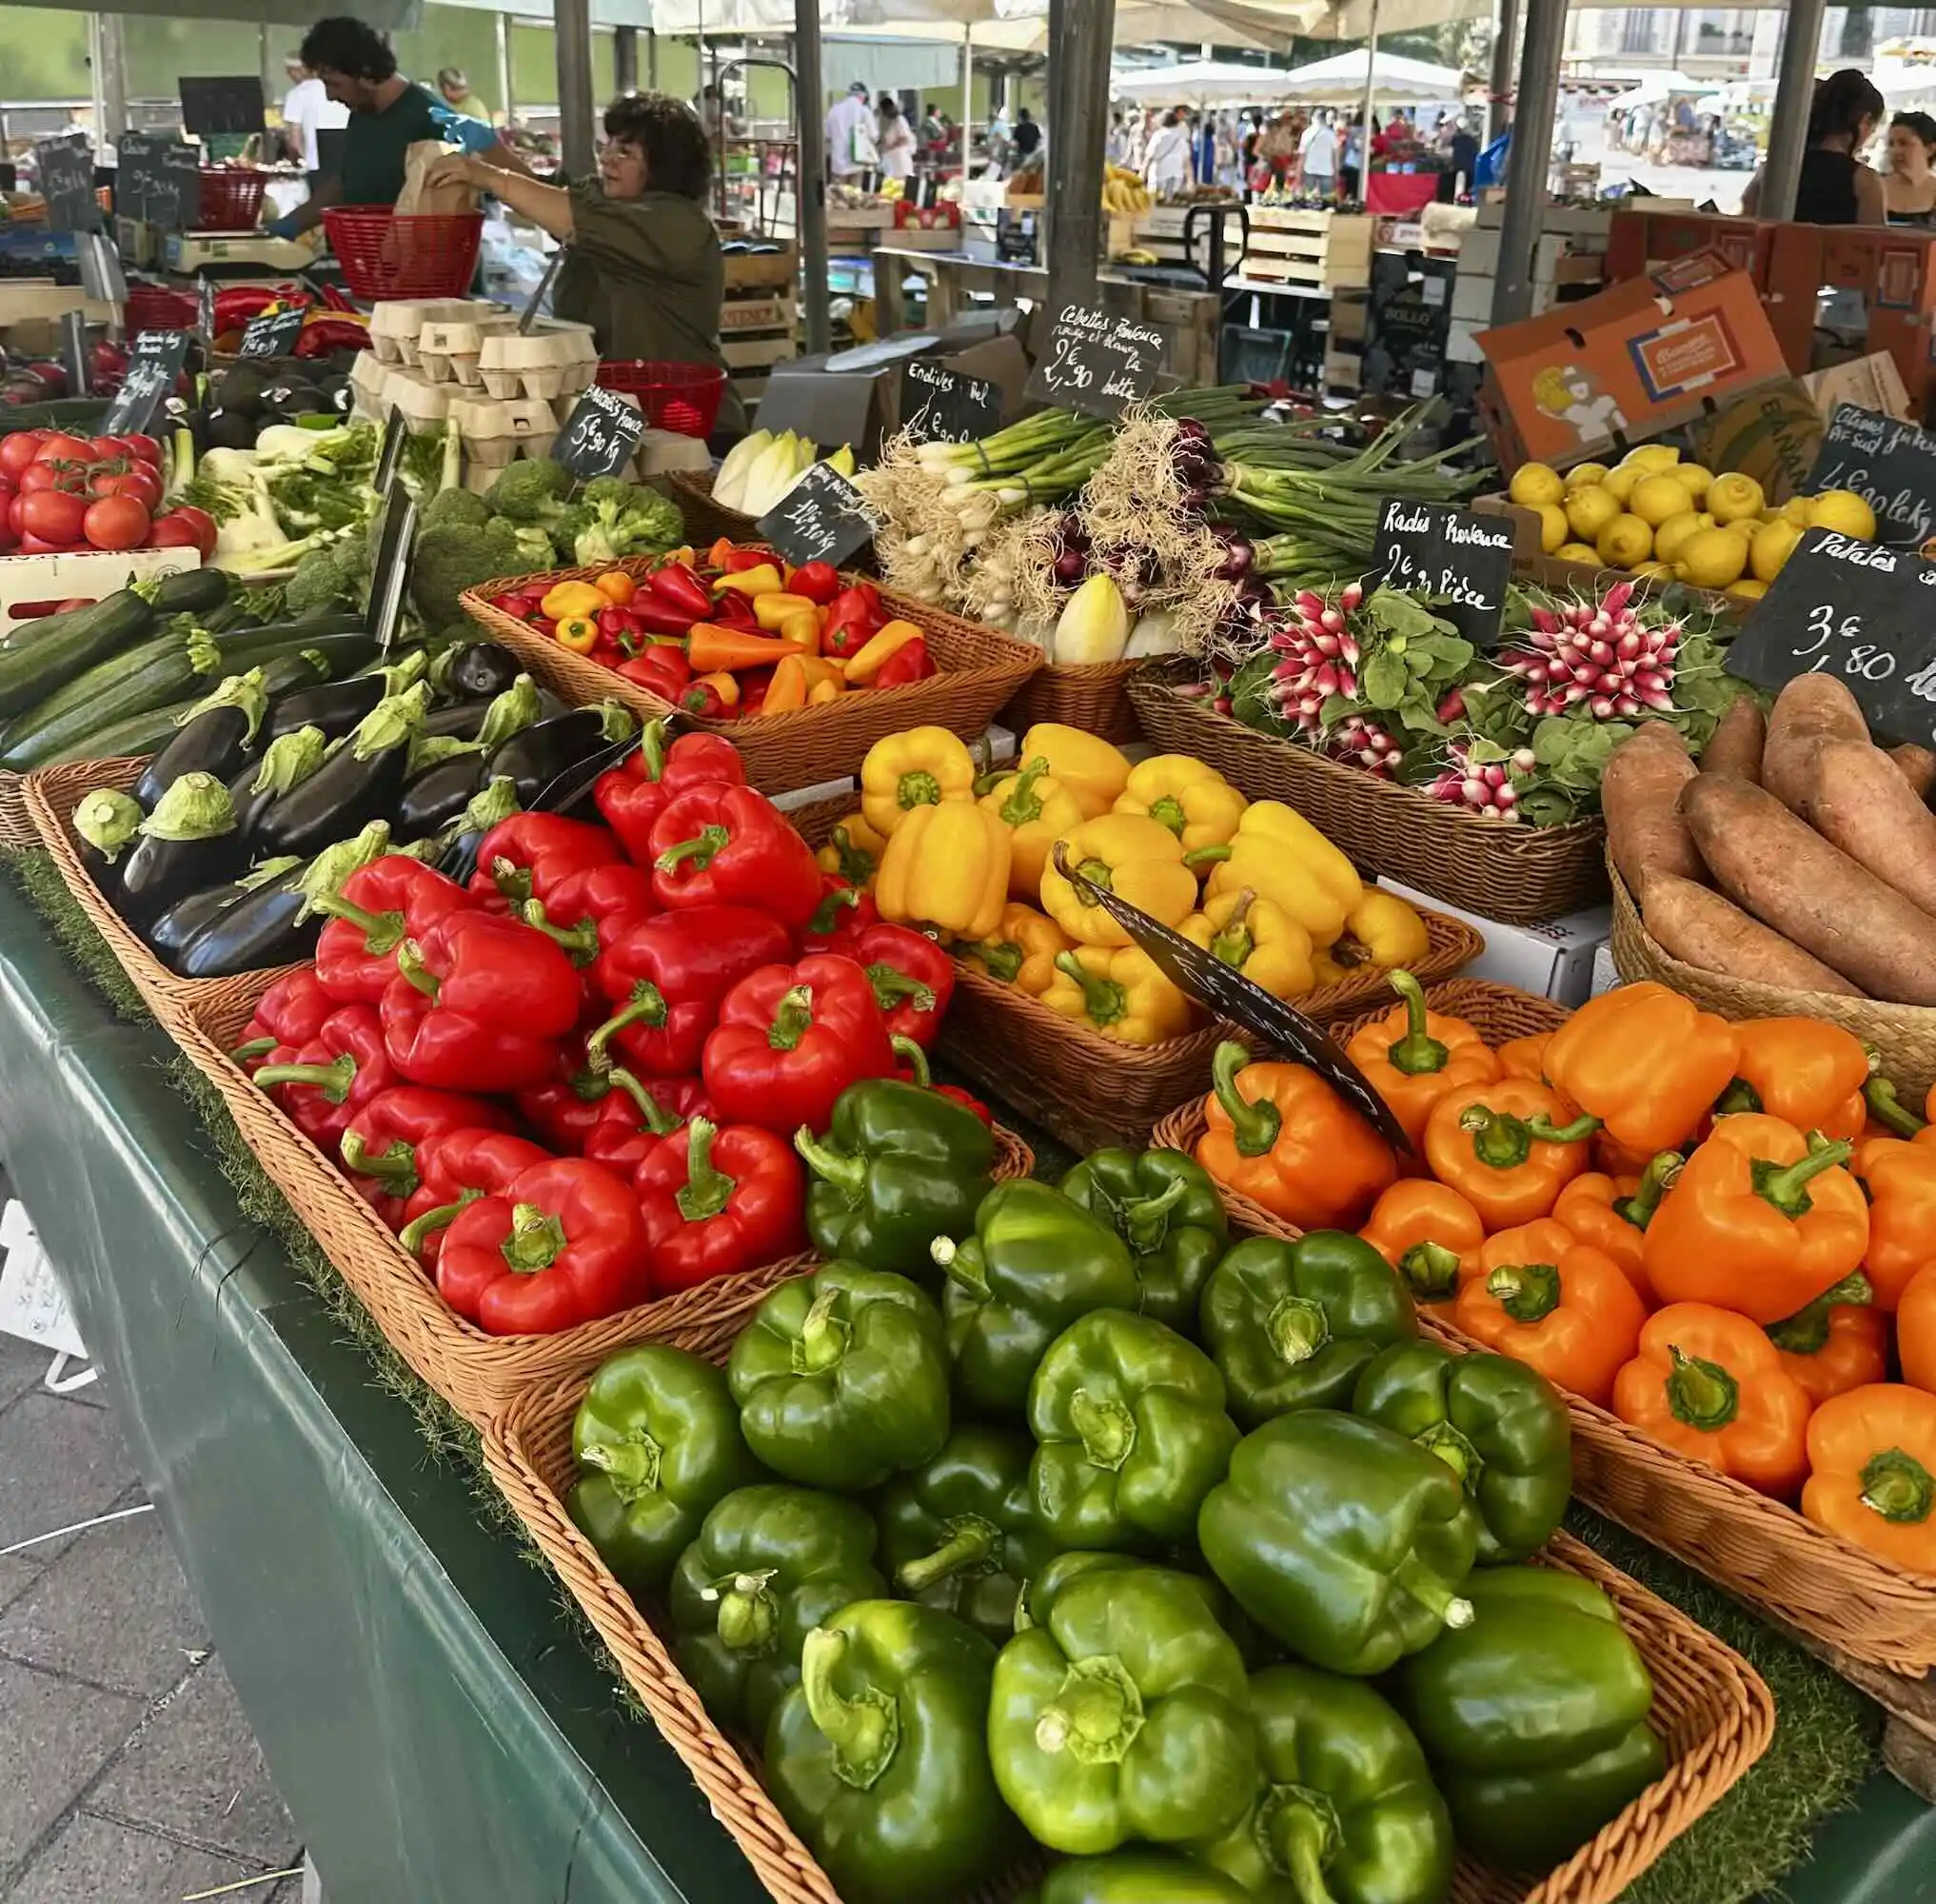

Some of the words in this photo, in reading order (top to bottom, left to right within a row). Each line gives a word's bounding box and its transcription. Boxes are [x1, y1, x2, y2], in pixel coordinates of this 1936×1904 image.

[909, 363, 955, 392] Endives
[1383, 502, 1431, 533] Radis
[1445, 514, 1513, 549] Provence
[1810, 532, 1897, 572] Patates
